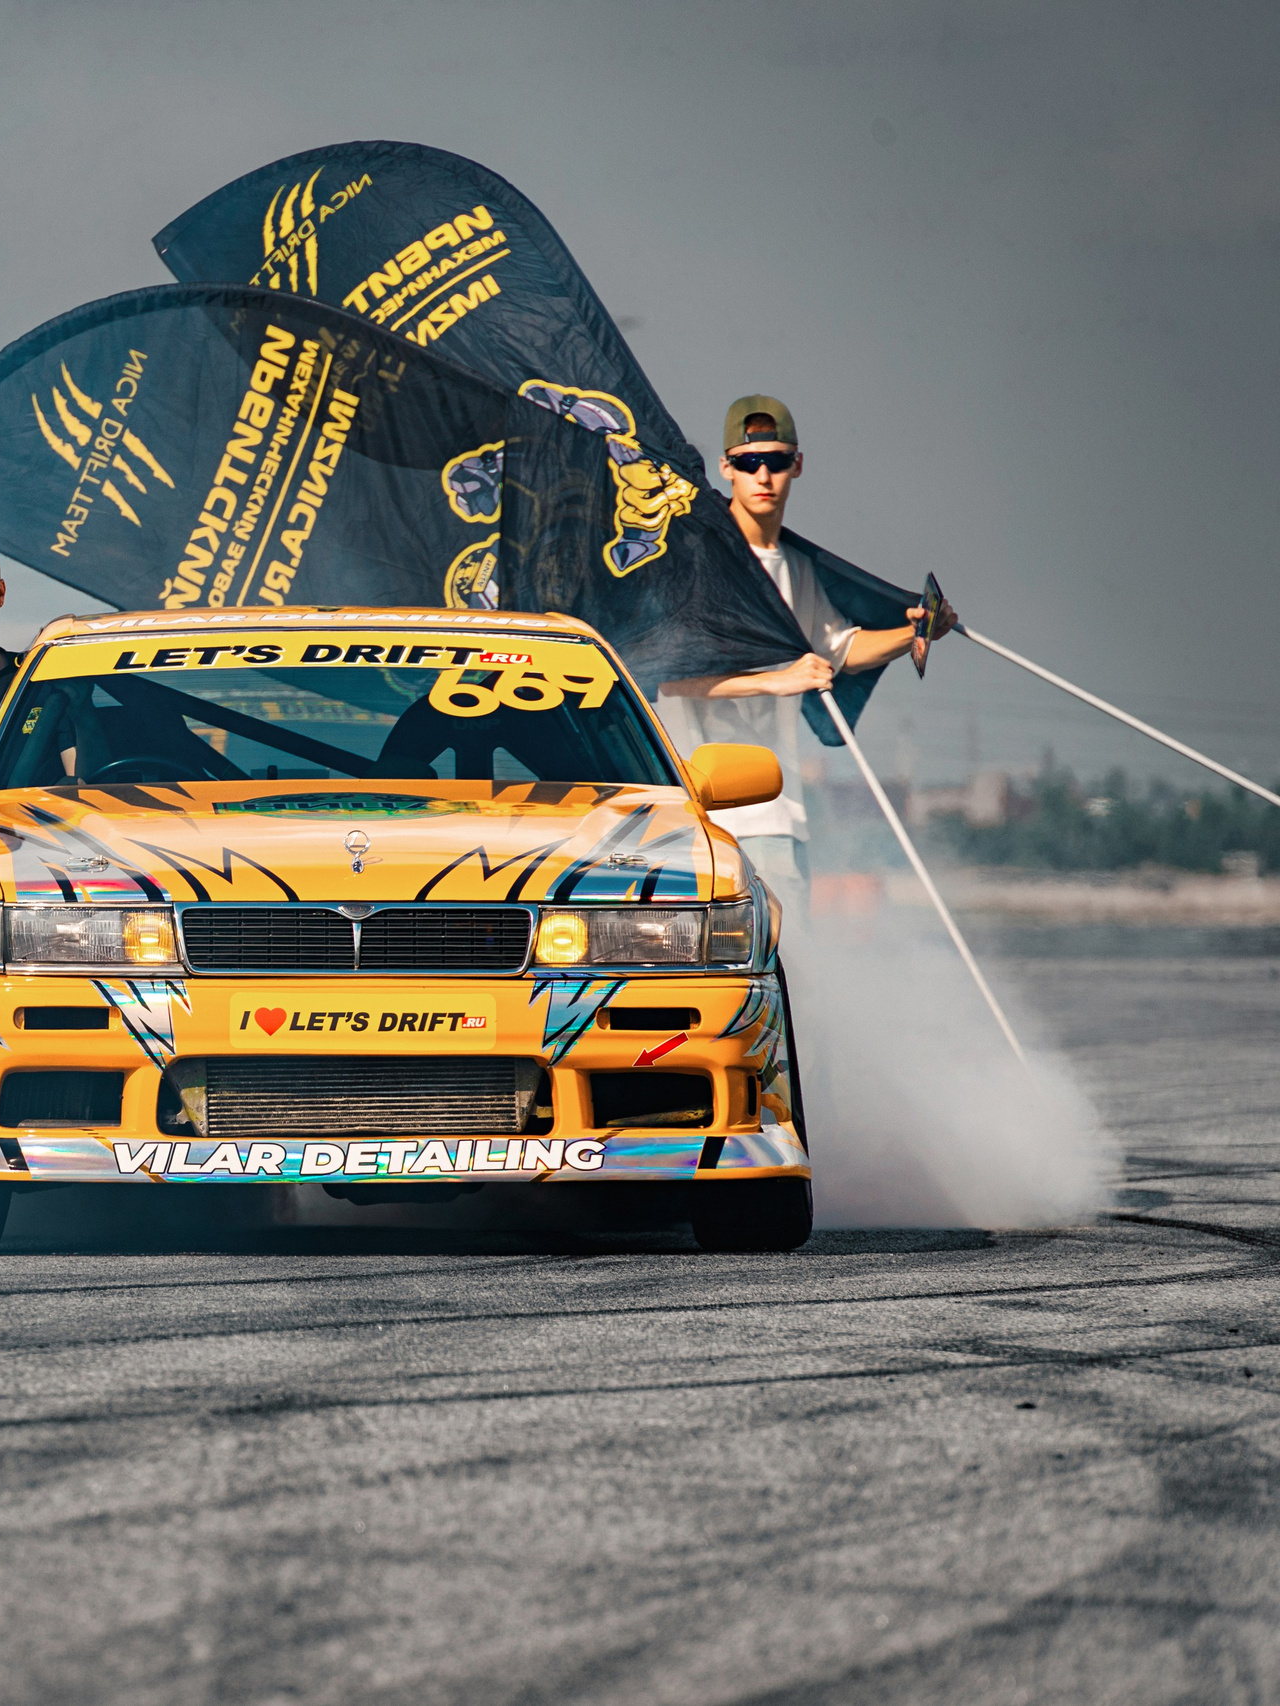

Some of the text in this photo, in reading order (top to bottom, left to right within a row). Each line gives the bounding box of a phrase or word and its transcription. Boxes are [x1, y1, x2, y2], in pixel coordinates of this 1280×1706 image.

[85, 612, 549, 631] VILAR DETAILING
[113, 644, 285, 671] LET'S
[428, 668, 615, 718] 669
[239, 1010, 251, 1031] I
[288, 1011, 370, 1032] LET'S
[112, 1138, 607, 1176] VILAR DETAILING
